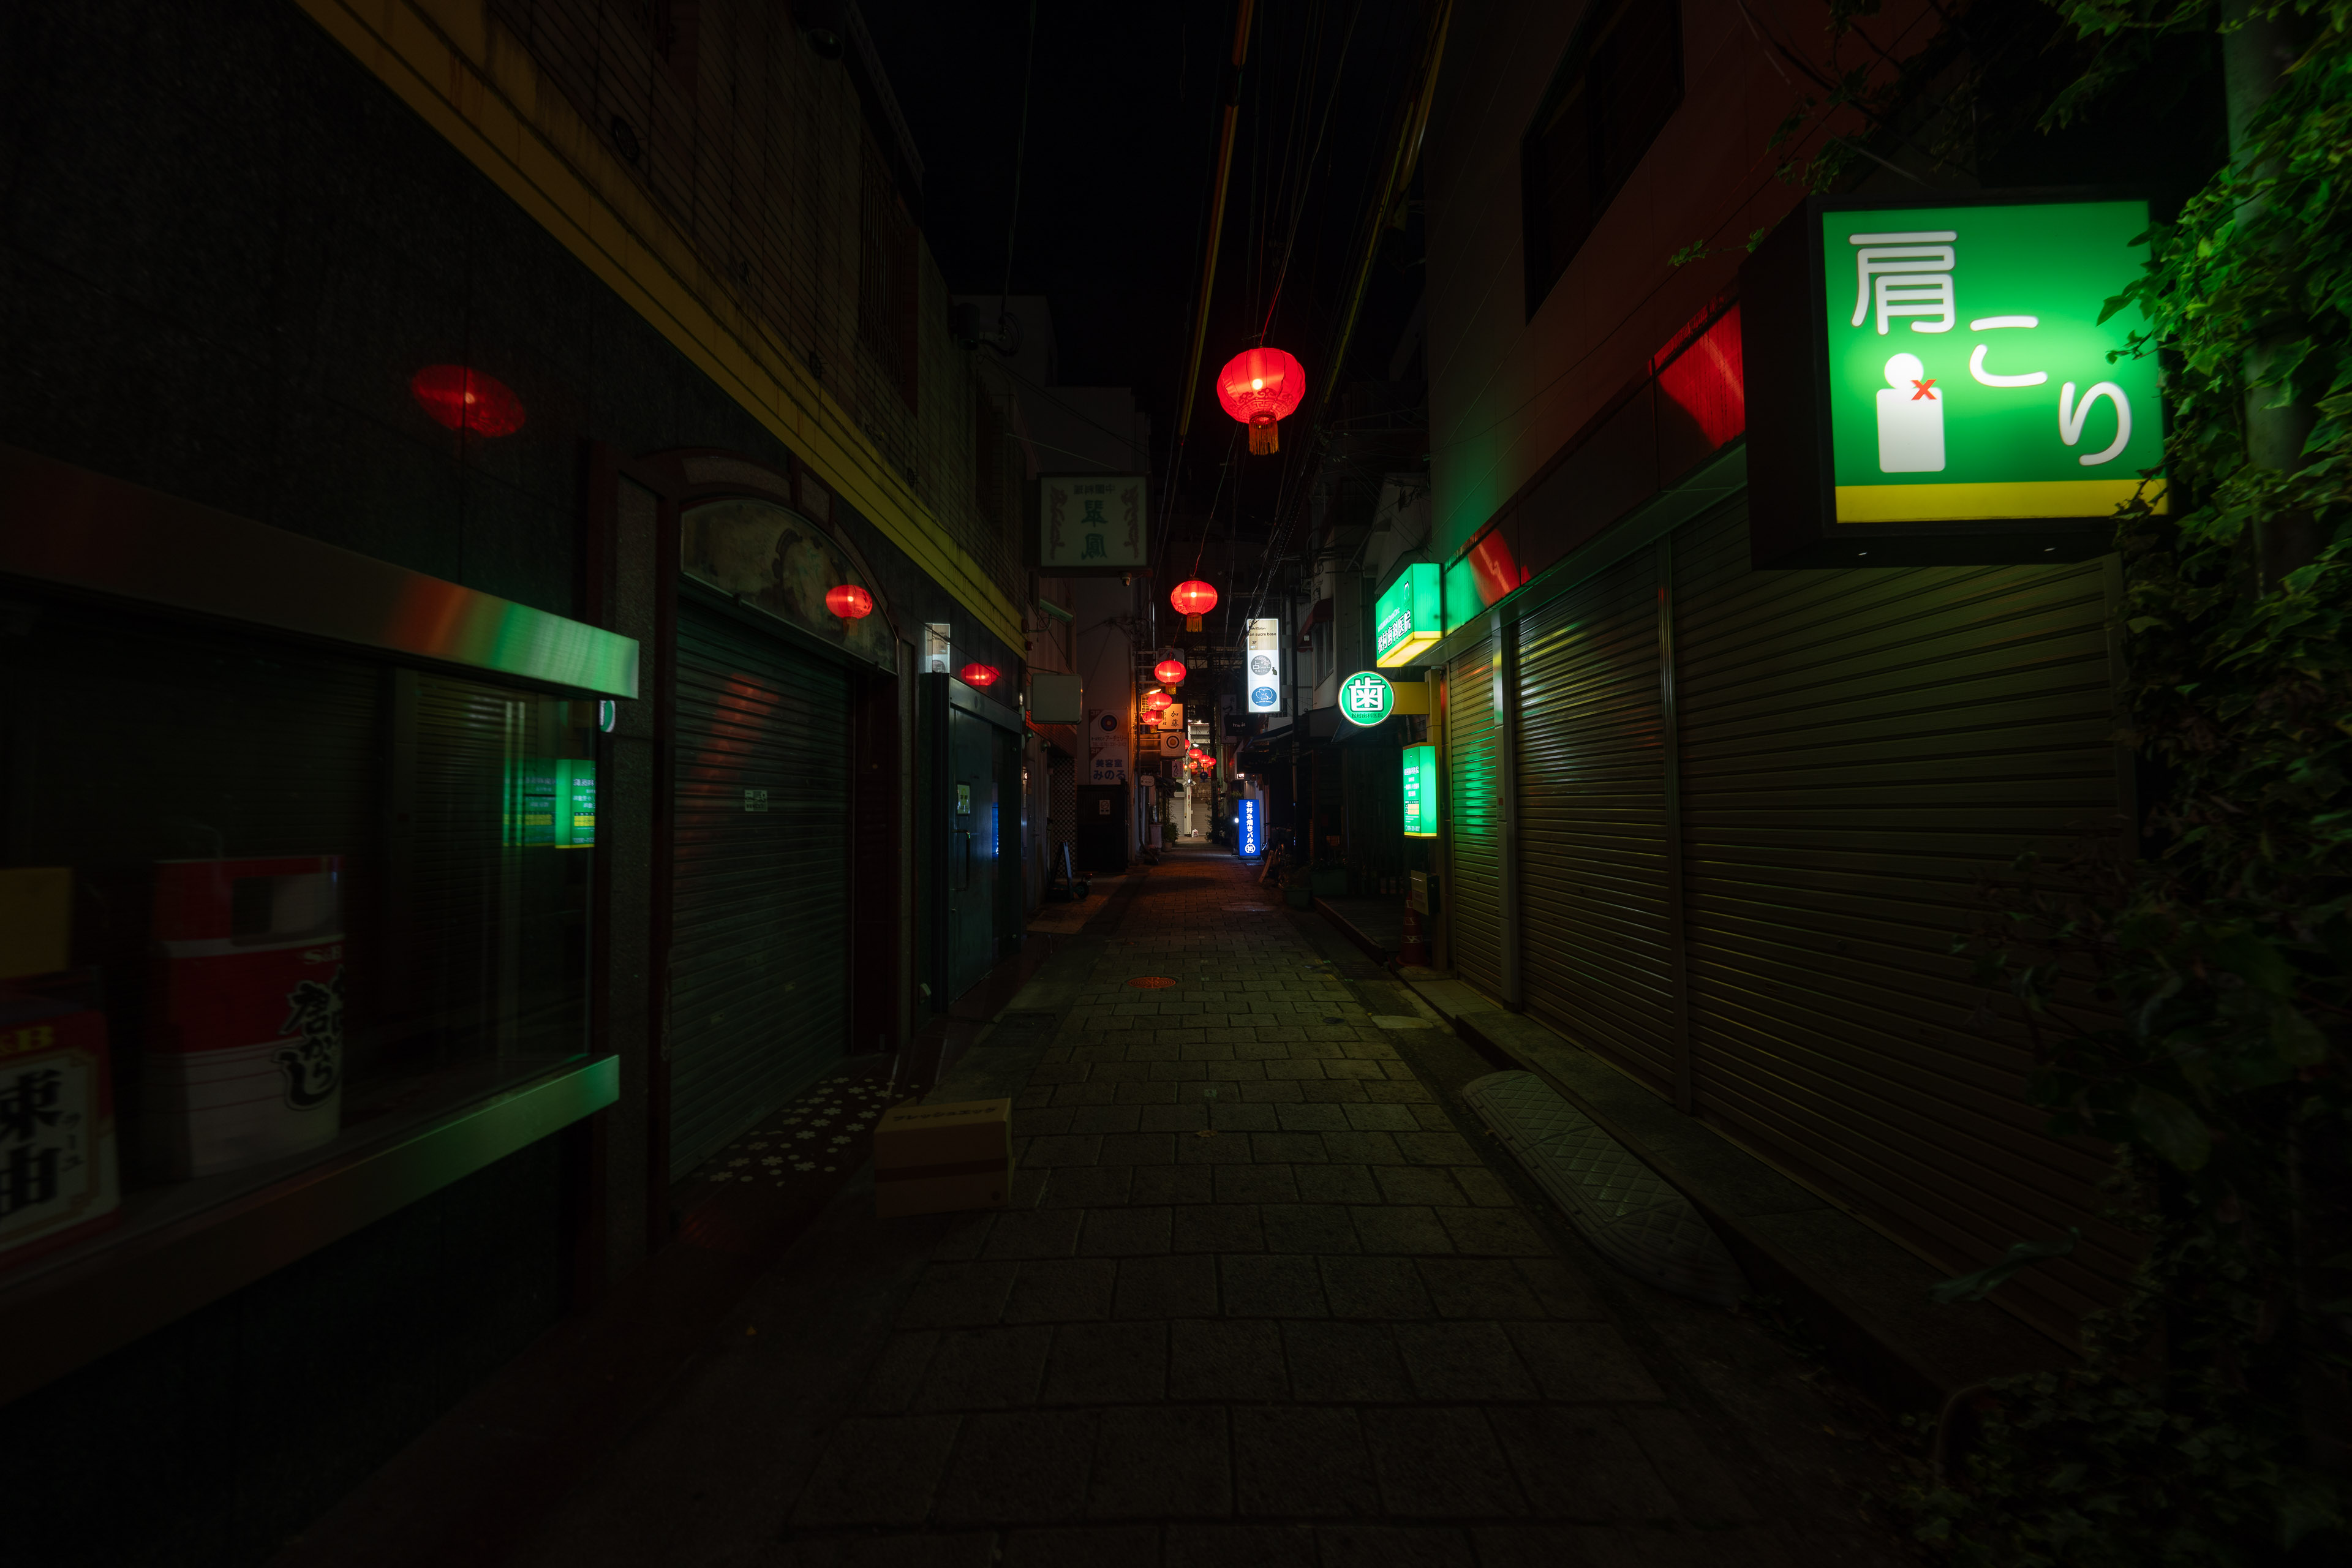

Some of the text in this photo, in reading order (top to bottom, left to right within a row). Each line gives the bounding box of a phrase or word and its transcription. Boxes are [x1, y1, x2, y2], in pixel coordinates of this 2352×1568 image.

[1849, 230, 2132, 466] 肩こり
[1378, 609, 1411, 655] 松村歯科医院
[1348, 676, 1386, 712] 歯
[1170, 710, 1179, 727] 加藤
[1093, 770, 1126, 780] みのる
[1096, 759, 1123, 767] 美容室
